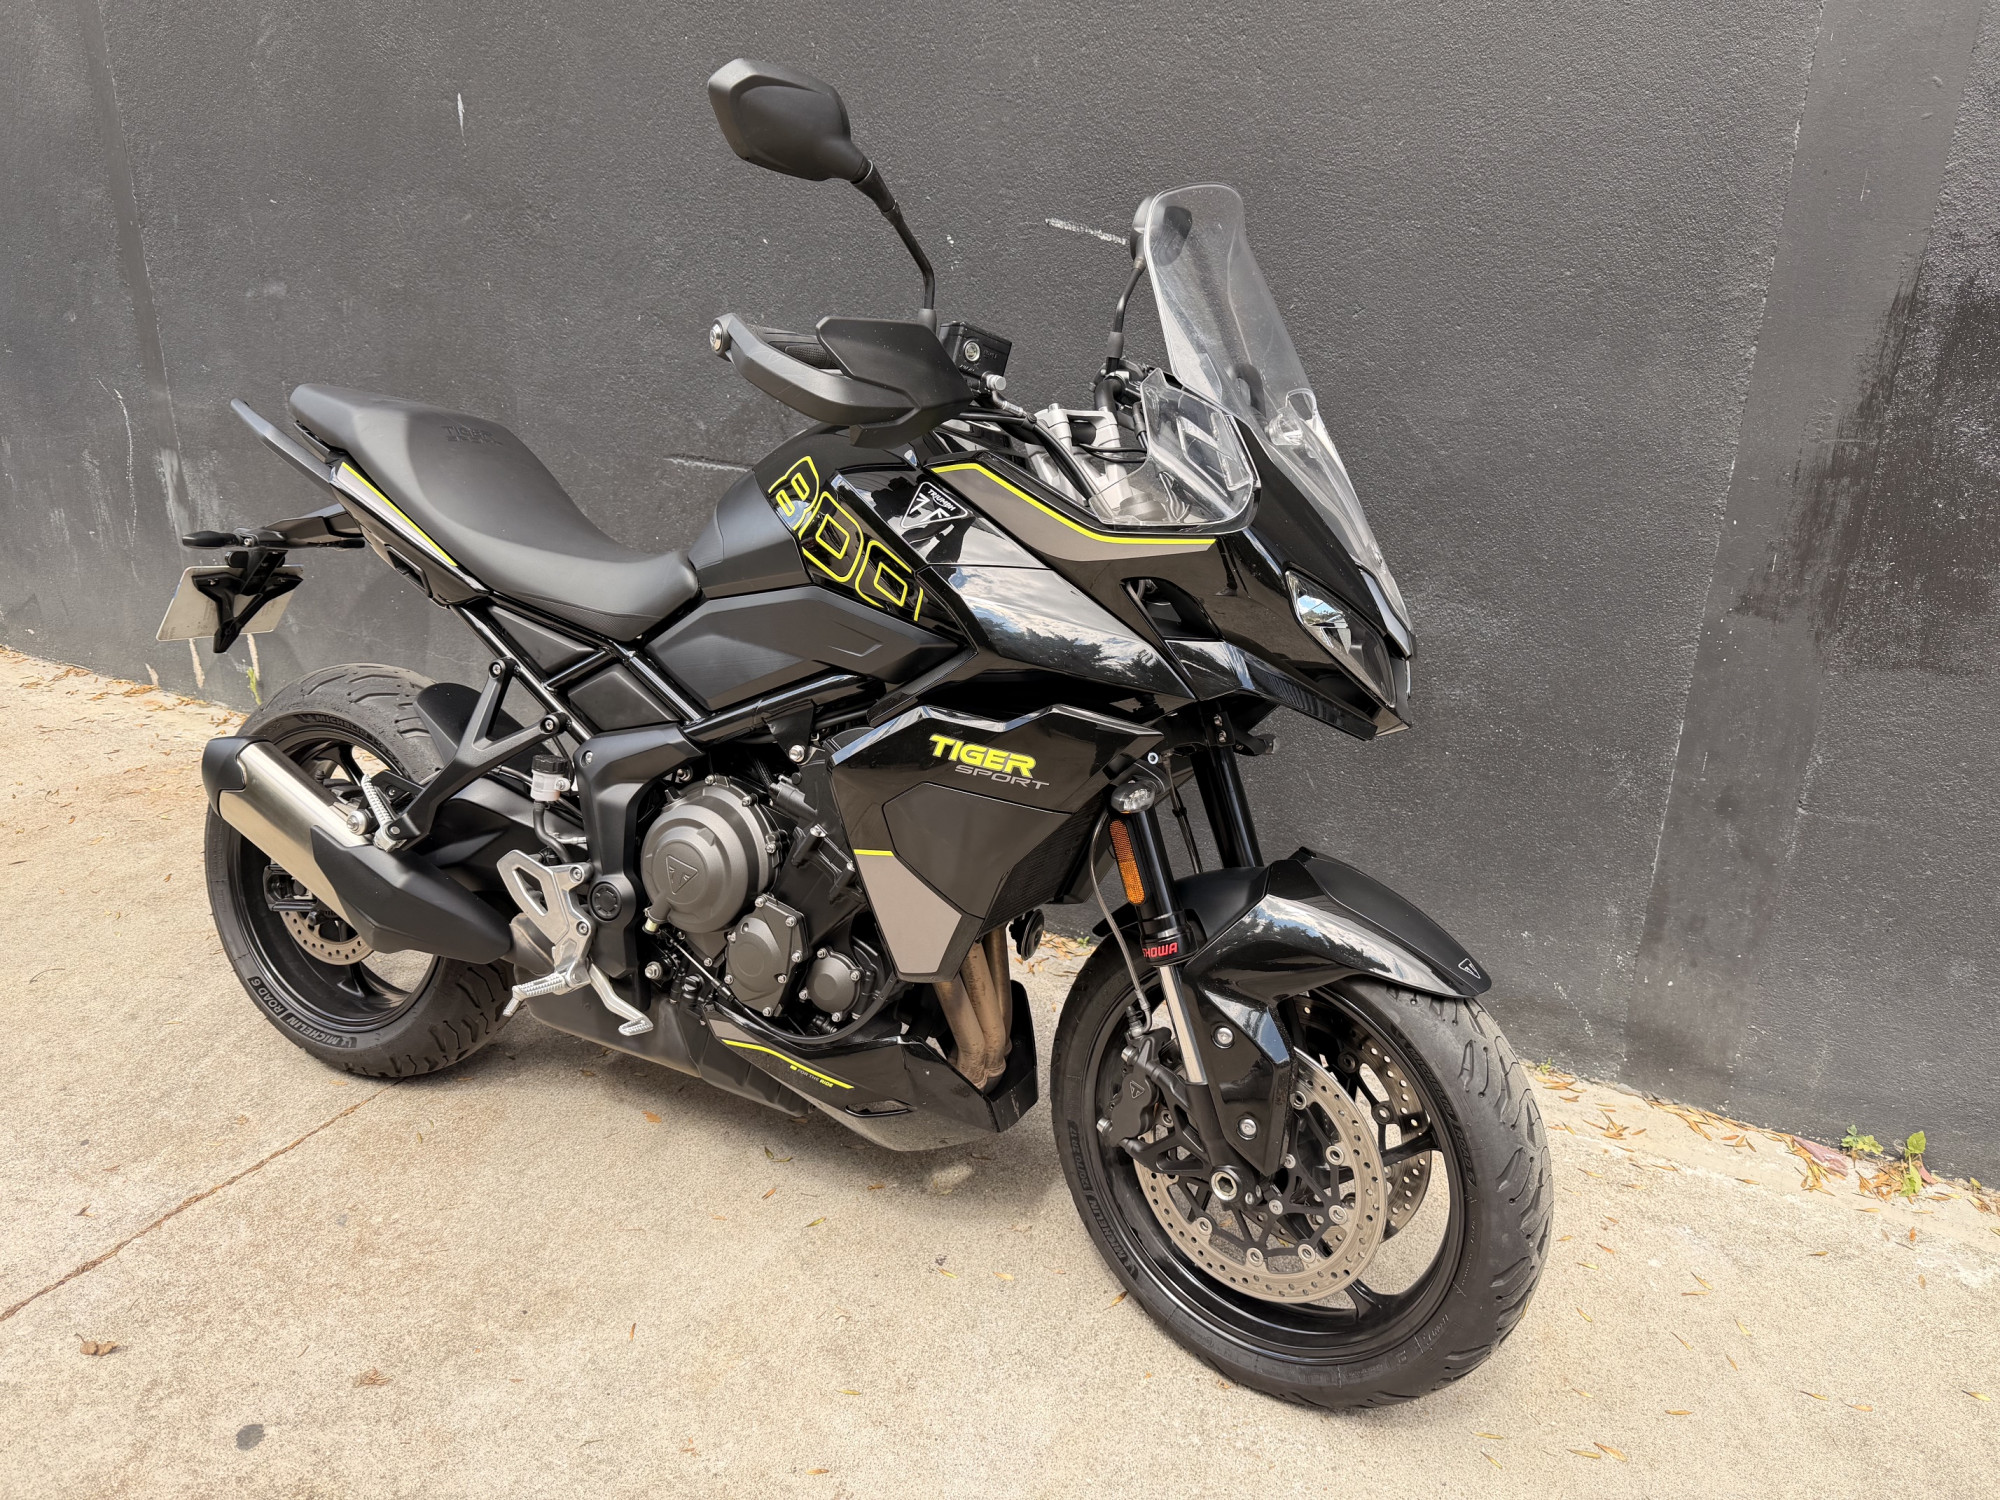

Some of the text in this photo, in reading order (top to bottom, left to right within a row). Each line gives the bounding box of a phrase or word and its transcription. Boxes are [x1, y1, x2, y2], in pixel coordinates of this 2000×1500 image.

[927, 489, 957, 511] TRIUMPH
[930, 734, 1036, 778] TIGER
[955, 764, 1050, 790] SPORT
[250, 977, 341, 1047] MICHELIN ROAD 6
[797, 1068, 834, 1088] FOR THE RIDE
[1455, 1128, 1472, 1167] ROAD
